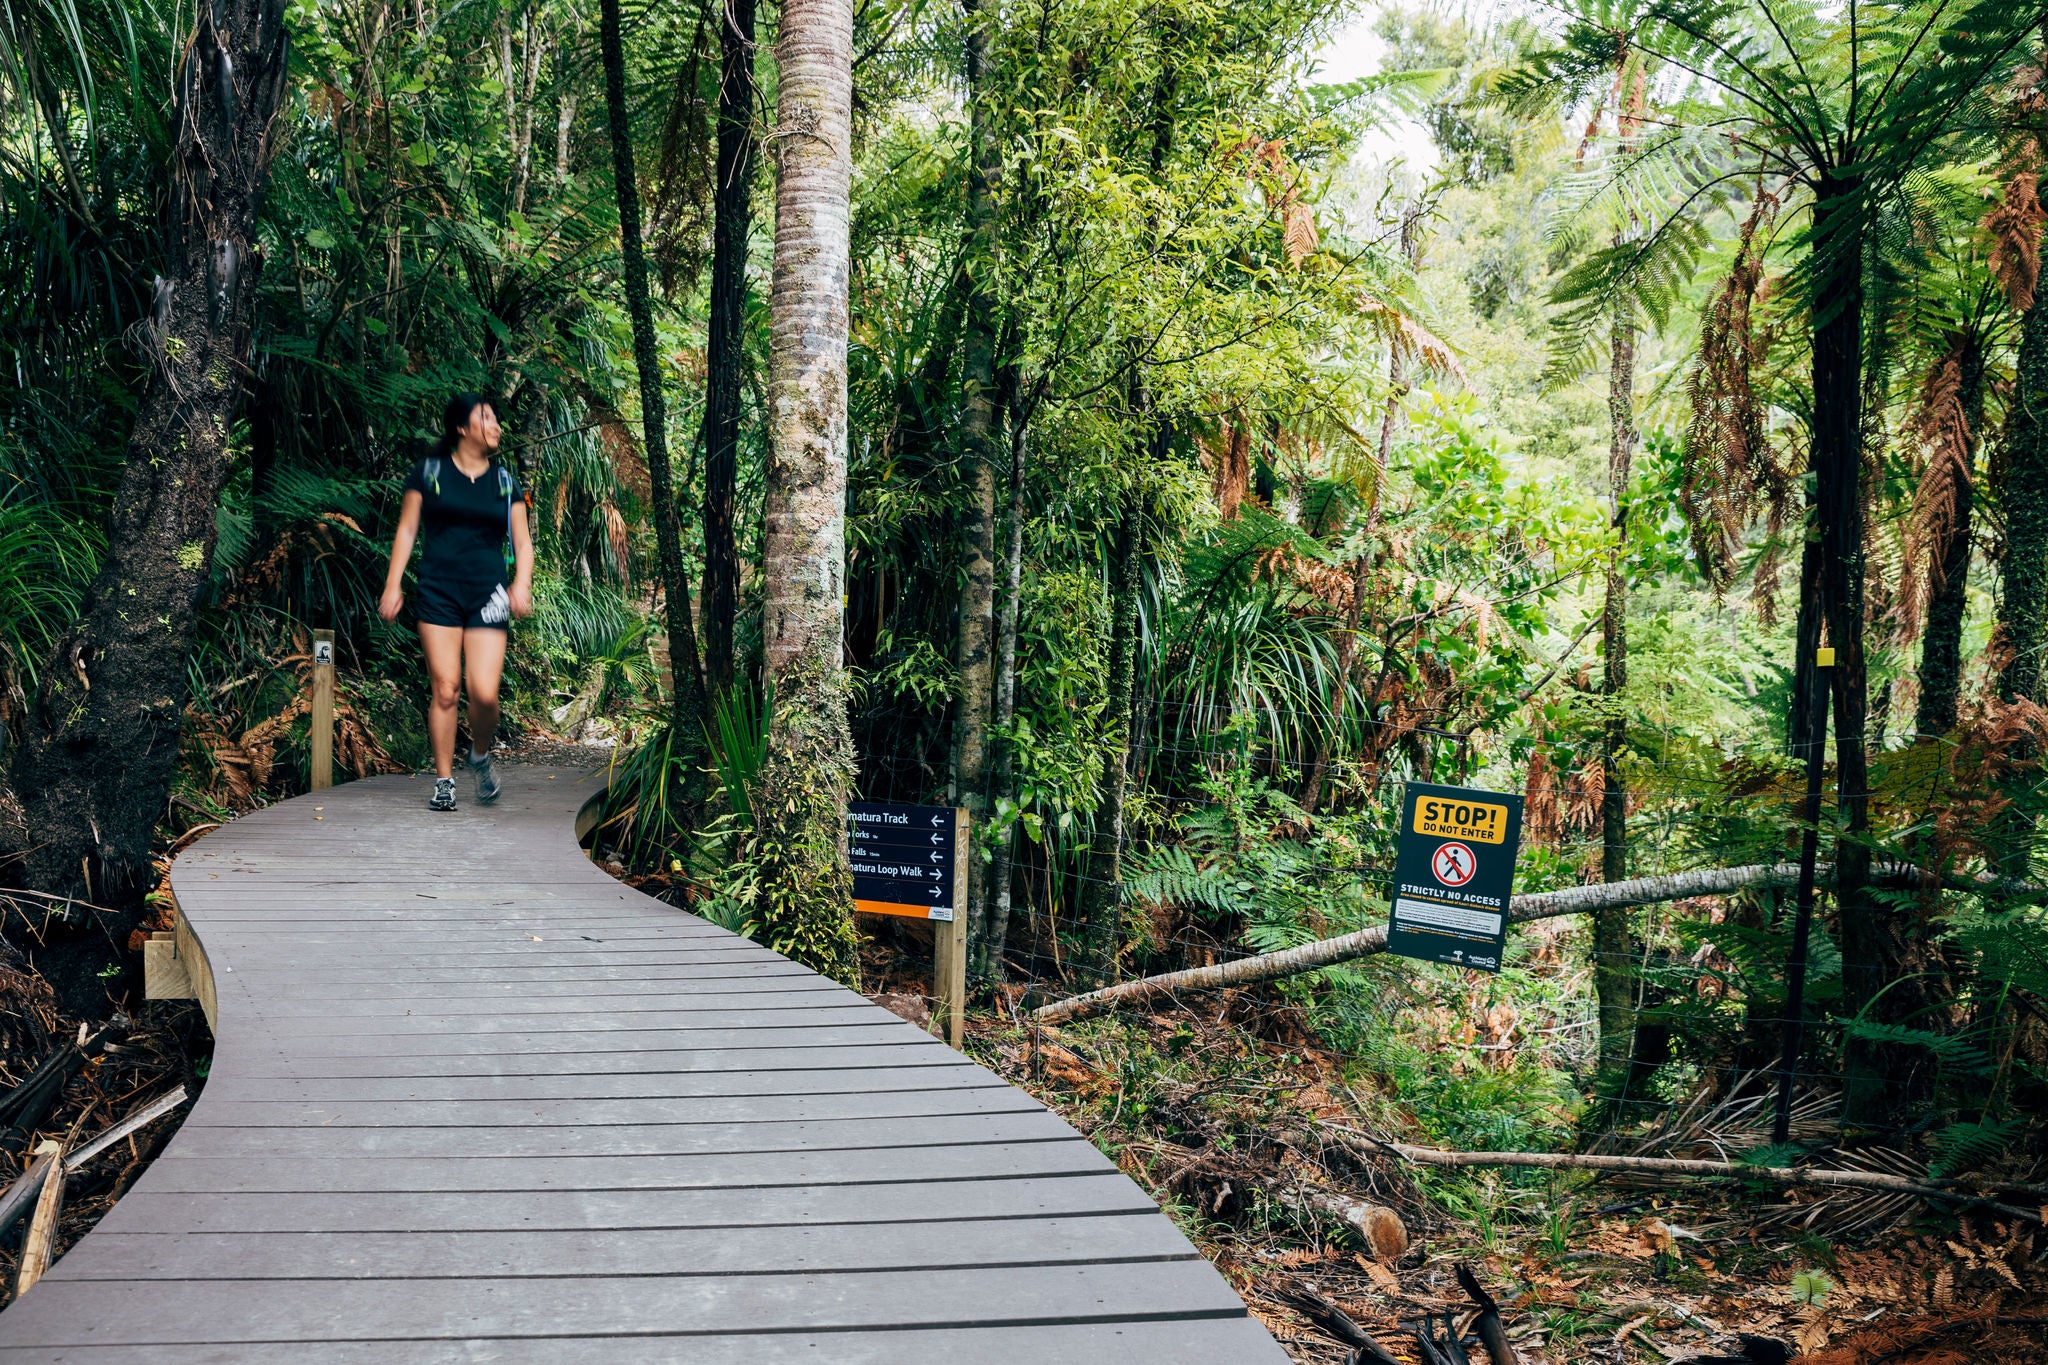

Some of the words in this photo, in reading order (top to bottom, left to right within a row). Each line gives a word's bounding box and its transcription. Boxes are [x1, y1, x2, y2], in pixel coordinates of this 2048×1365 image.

[883, 812, 909, 825] Track
[1424, 801, 1497, 829] STOP!
[1423, 822, 1437, 832] DO
[1439, 824, 1459, 835] NOT
[1461, 827, 1495, 840] ENTER
[851, 847, 867, 857] Falls
[877, 864, 899, 878] Loop
[900, 865, 923, 878] Walk
[1400, 884, 1446, 898] STRICTLY
[1447, 891, 1461, 900] NO
[1463, 893, 1501, 907] ACCESS
